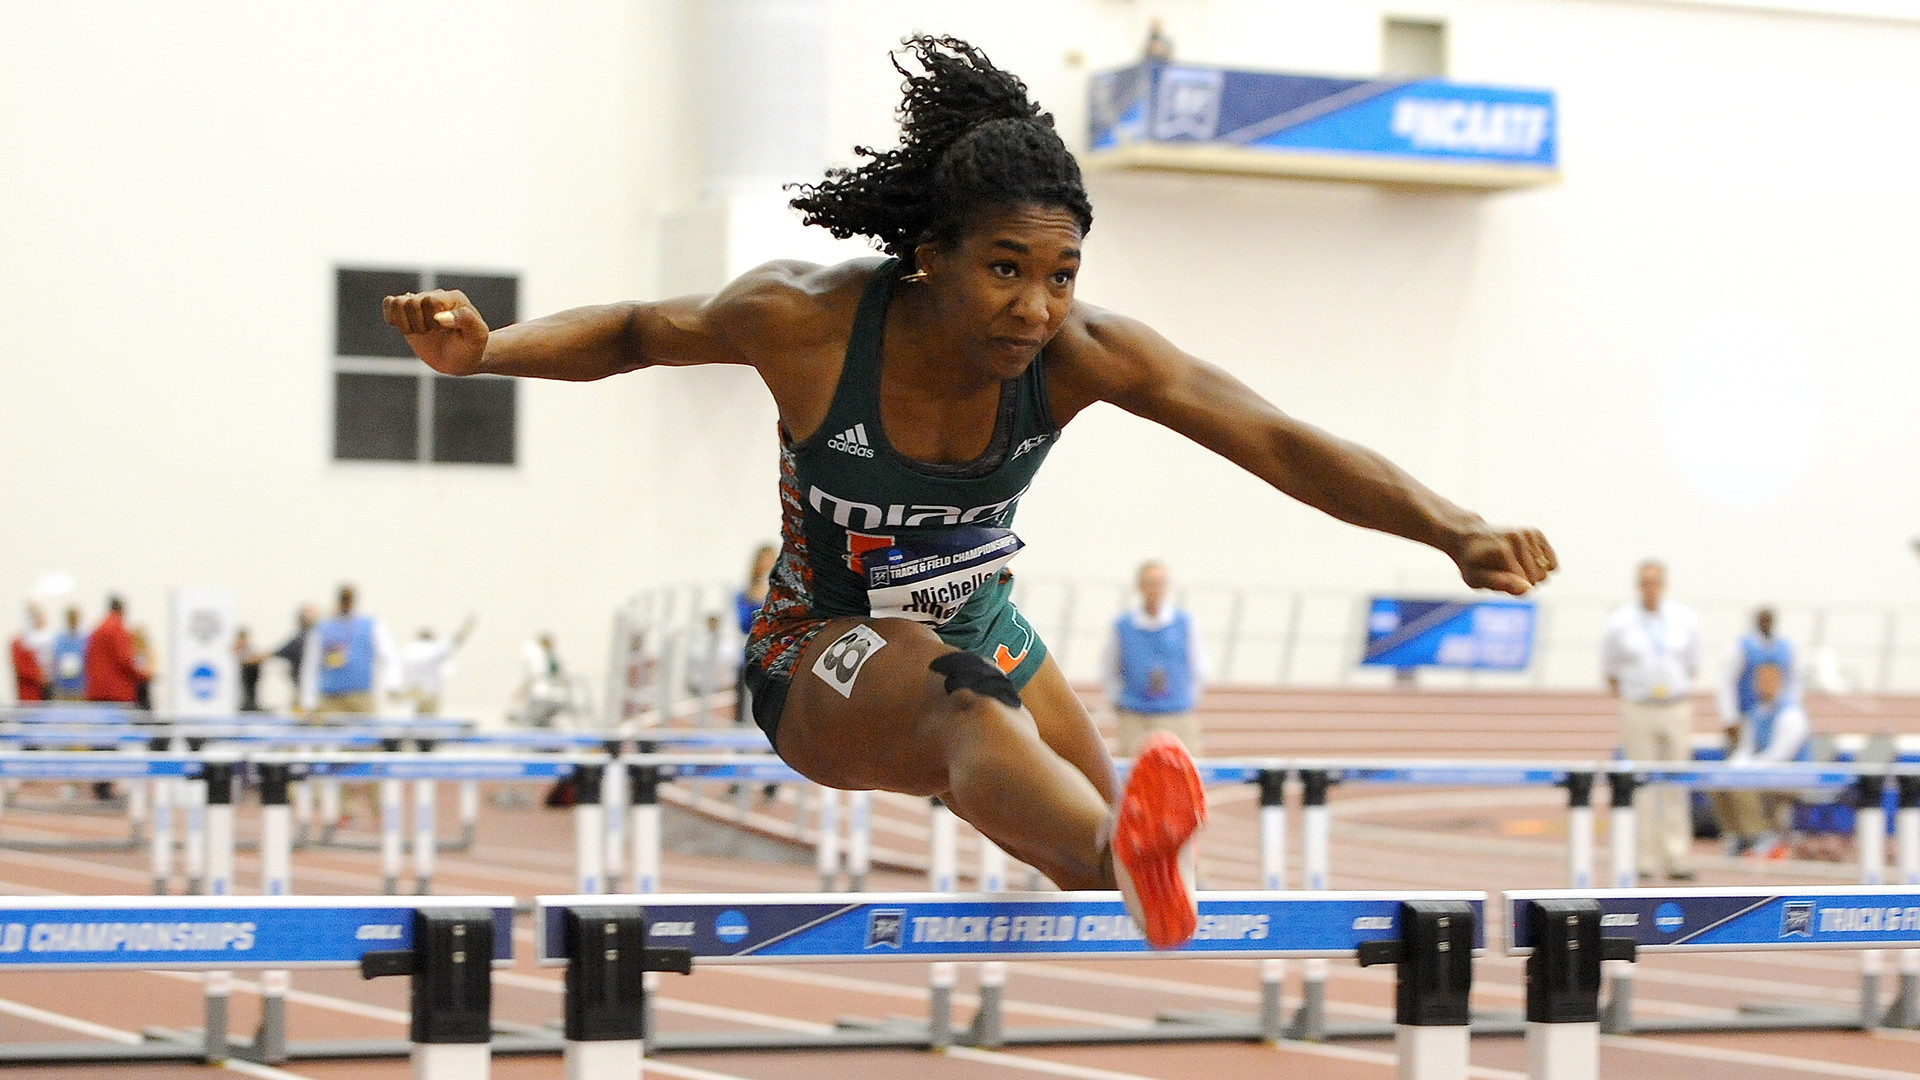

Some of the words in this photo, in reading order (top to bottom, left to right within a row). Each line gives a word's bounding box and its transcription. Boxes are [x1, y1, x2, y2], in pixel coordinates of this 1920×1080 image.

[827, 439, 875, 459] adidas
[890, 564, 919, 579] TRACK
[927, 556, 951, 571] FIELD
[952, 534, 1017, 564] CHAMPIONSHIPS
[912, 916, 990, 943] TRACK
[1009, 915, 1076, 942] FIELD
[1818, 907, 1885, 932] TRACK
[28, 922, 257, 952] CHAMPIONSHIPS
